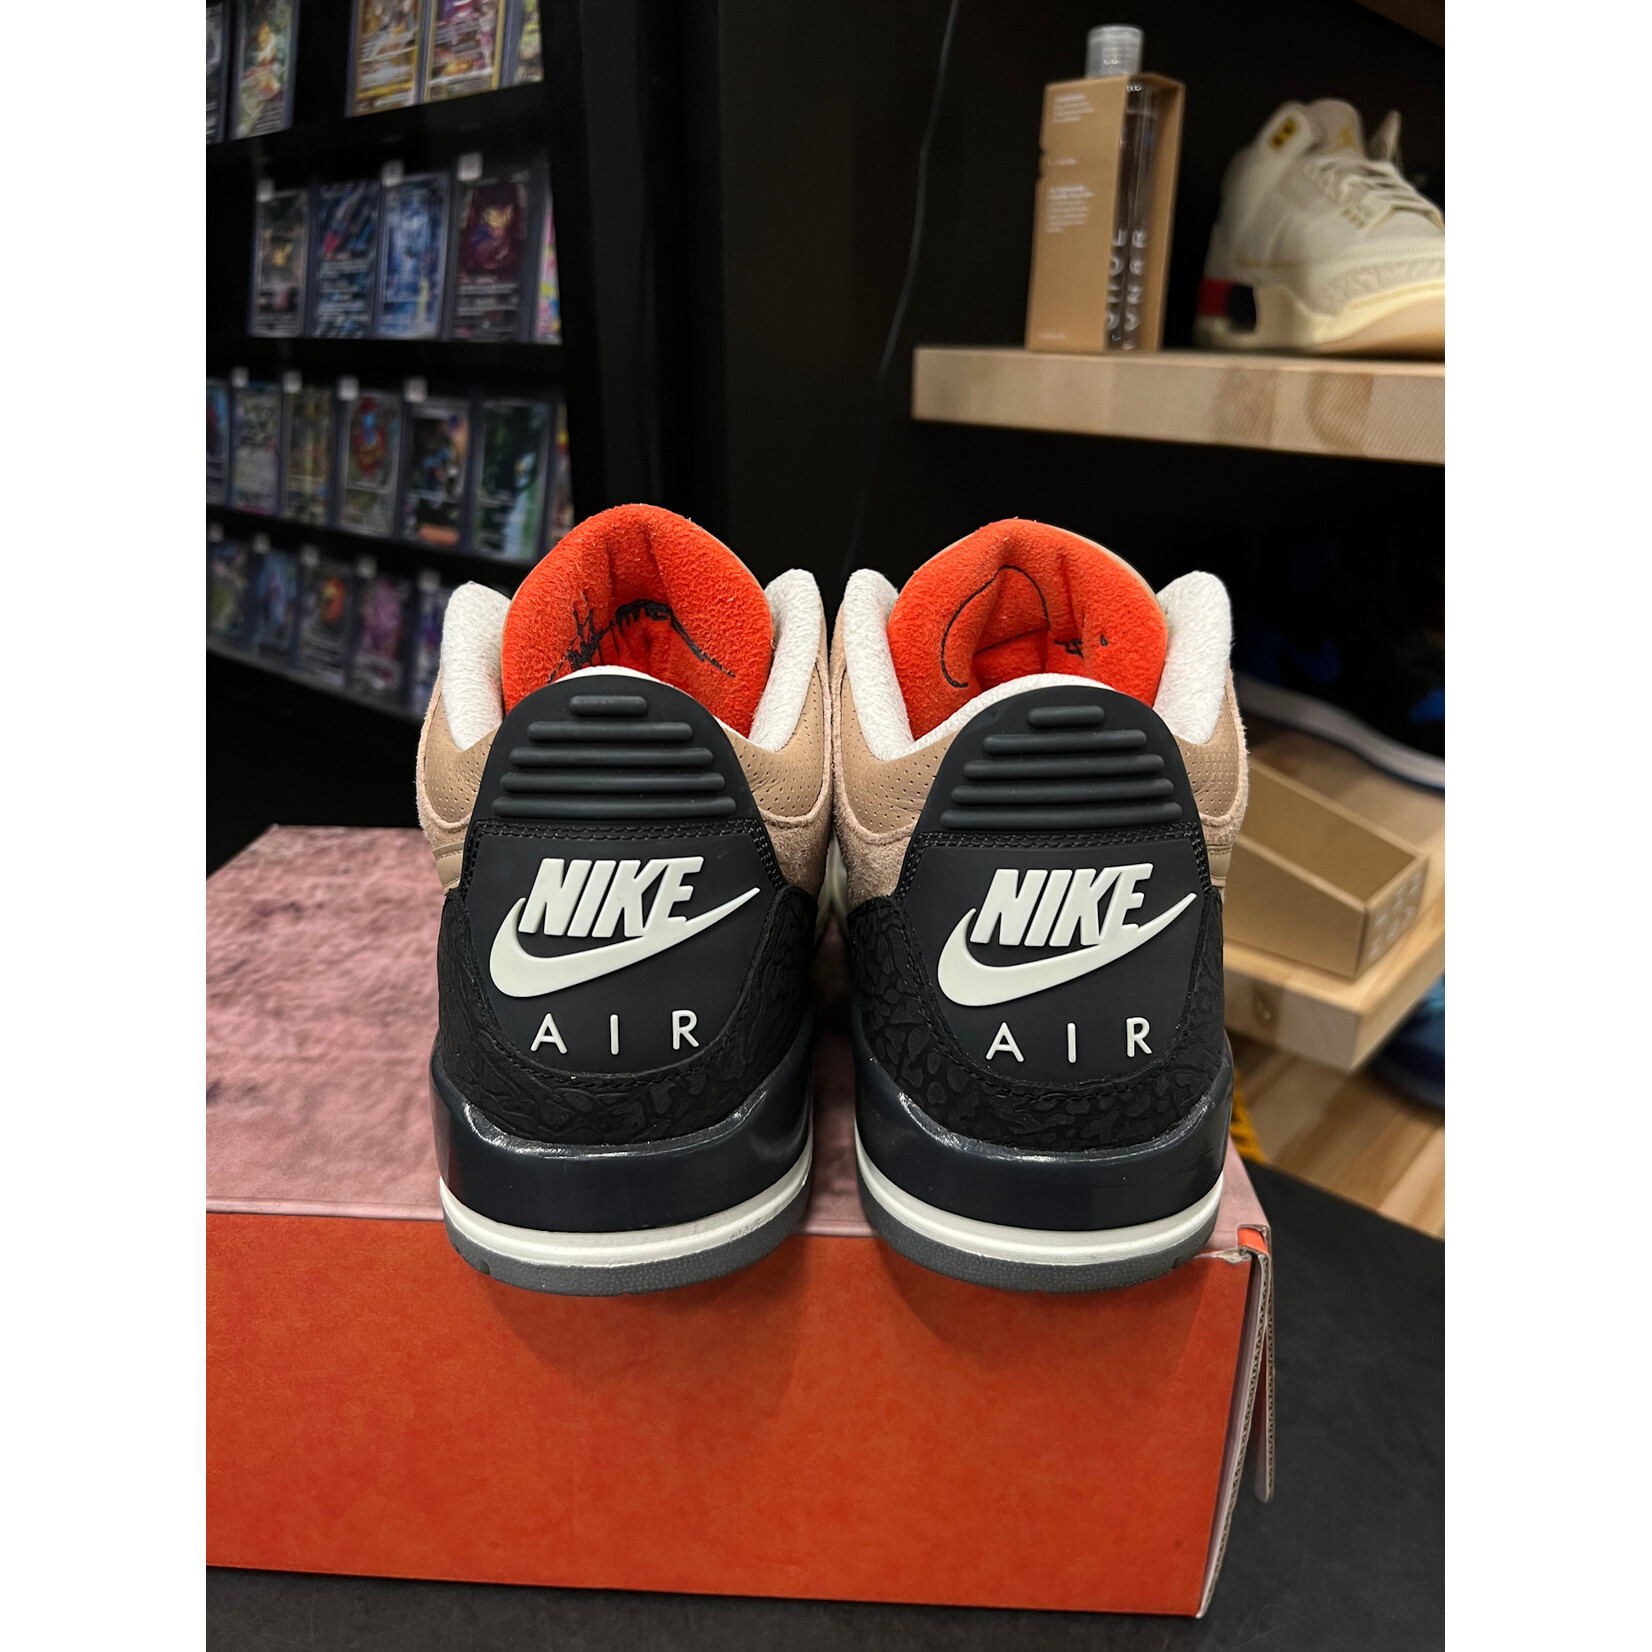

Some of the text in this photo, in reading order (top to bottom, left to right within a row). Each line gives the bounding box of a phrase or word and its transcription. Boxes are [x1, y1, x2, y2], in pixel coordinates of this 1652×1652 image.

[518, 856, 704, 938] NIKE
[969, 863, 1154, 947] NIKE
[530, 1010, 700, 1055] AIR
[985, 1017, 1152, 1063] AIR
